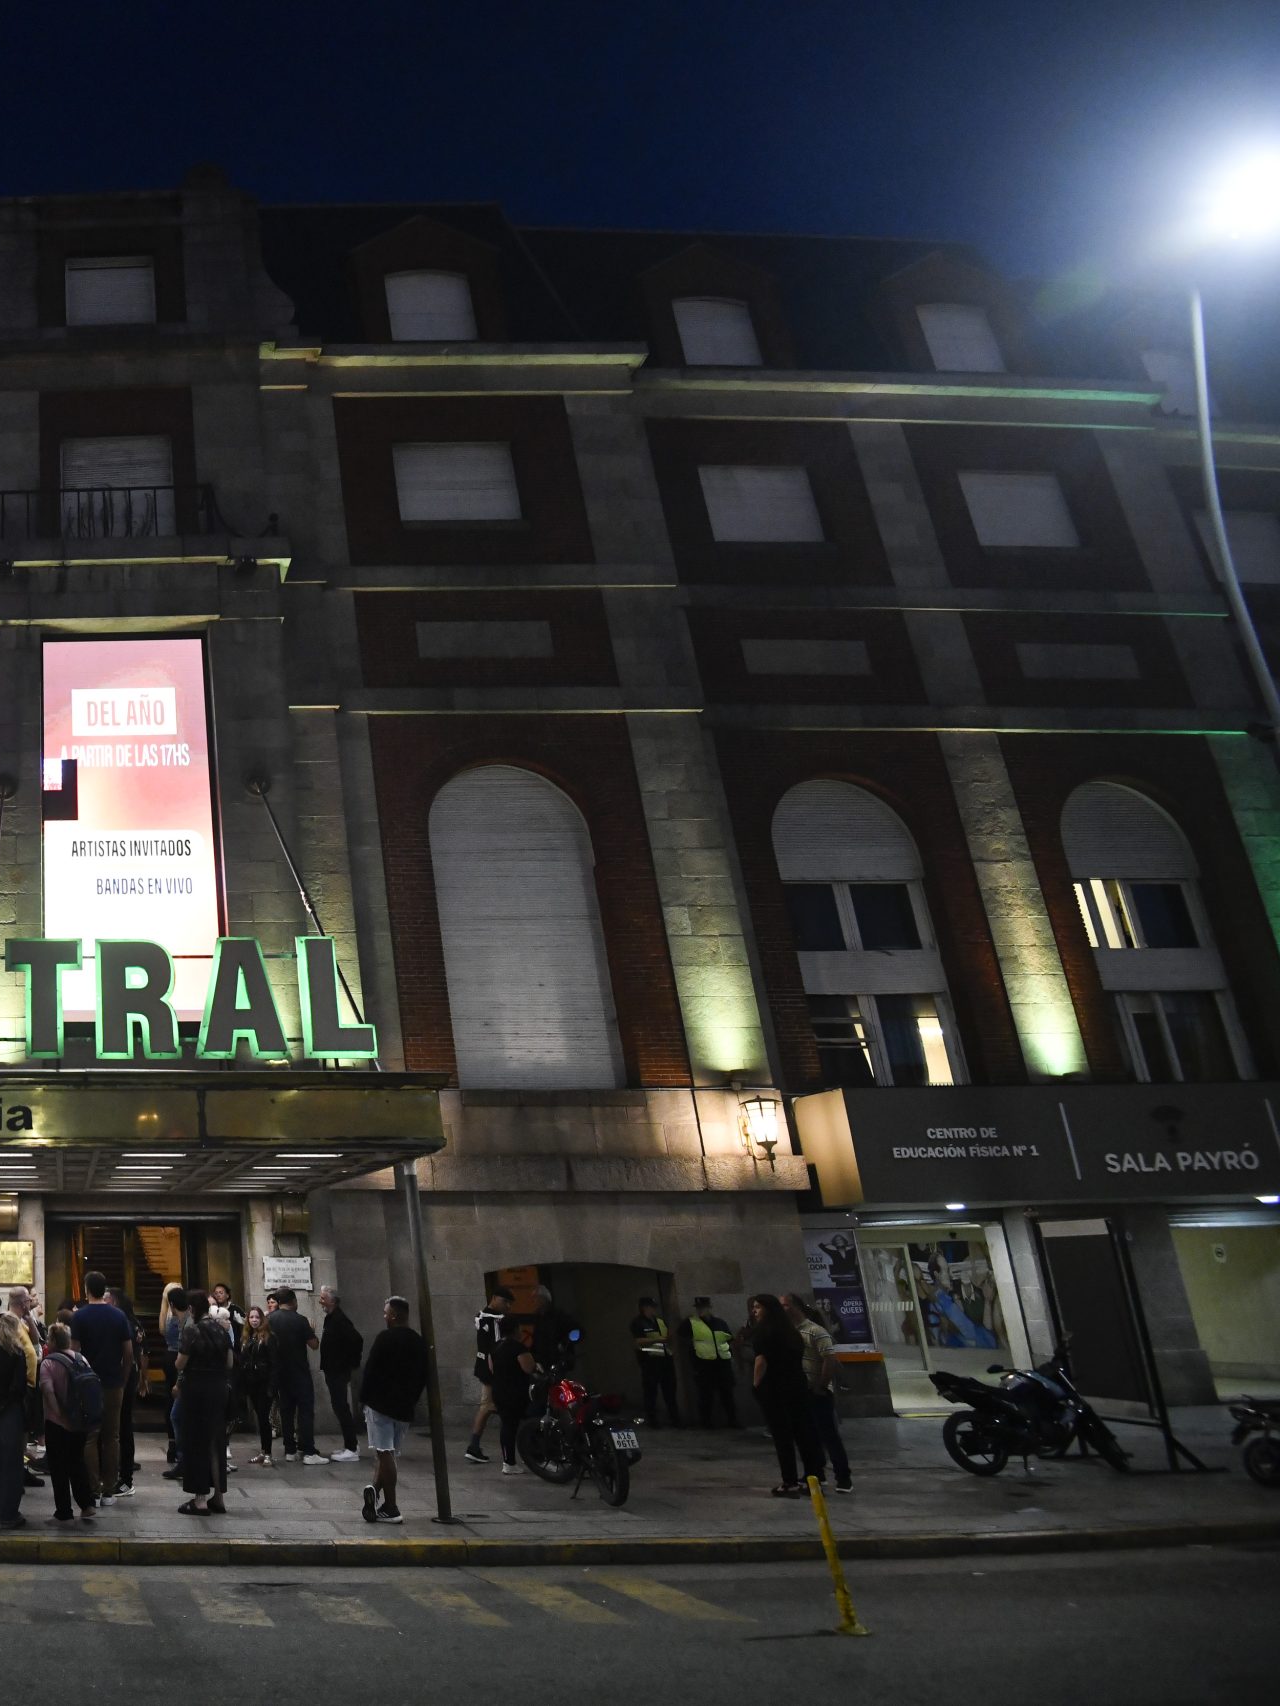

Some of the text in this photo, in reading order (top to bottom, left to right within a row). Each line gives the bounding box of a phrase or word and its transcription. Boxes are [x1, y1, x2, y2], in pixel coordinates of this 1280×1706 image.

[87, 694, 165, 727] DEL AÑO
[72, 745, 113, 767] PARTIR
[115, 744, 132, 767] DE
[135, 744, 158, 767] LAS
[160, 743, 190, 766] 17HS
[72, 839, 192, 857] ARTISTAS INVITADOS
[96, 877, 193, 895] BANDAS EN VIVO
[926, 1127, 998, 1139] CENTRO DE
[892, 1143, 967, 1159] EDUCACIÓN
[969, 1143, 1010, 1158] FÍSICA
[1029, 1145, 1039, 1156] 1
[1104, 1142, 1260, 1173] SALA PAYRÓ
